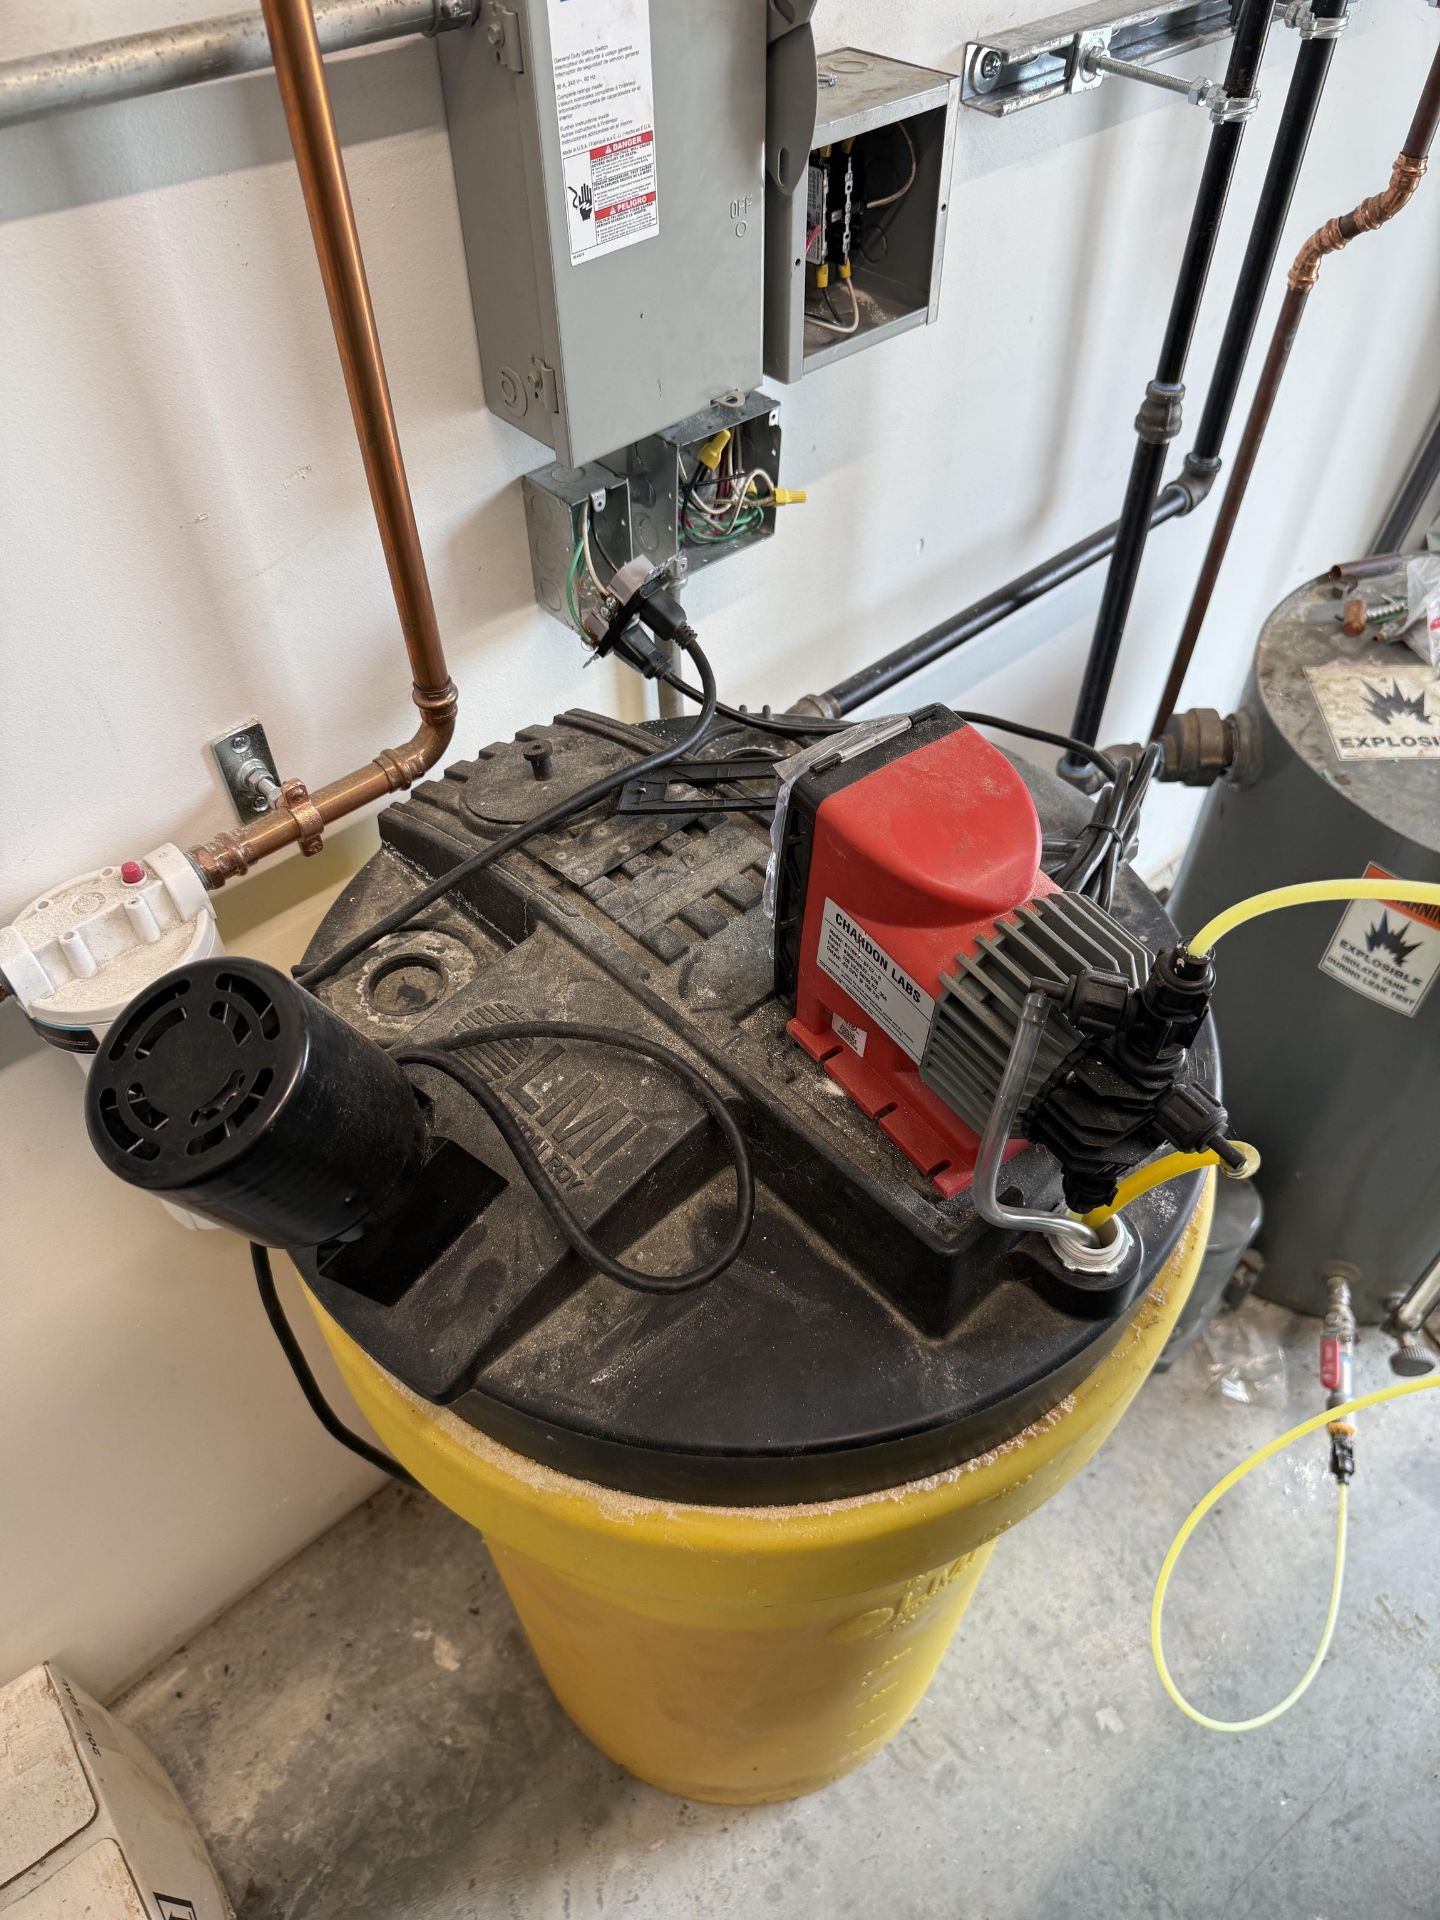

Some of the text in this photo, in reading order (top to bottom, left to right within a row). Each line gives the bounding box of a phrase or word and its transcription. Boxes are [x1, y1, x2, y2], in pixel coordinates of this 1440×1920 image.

[613, 135, 642, 151] DANGER
[617, 196, 647, 210] PELIGRO
[730, 193, 752, 218] OFF
[835, 913, 888, 971] CHARDON
[891, 967, 921, 1003] LABS
[1327, 956, 1360, 980] DURING
[1362, 977, 1387, 993] LEAK
[1340, 940, 1422, 987] EXPLOSIBLE
[1343, 955, 1379, 979] ISOLATE
[1382, 978, 1406, 993] TANK
[505, 1043, 646, 1175] LMI
